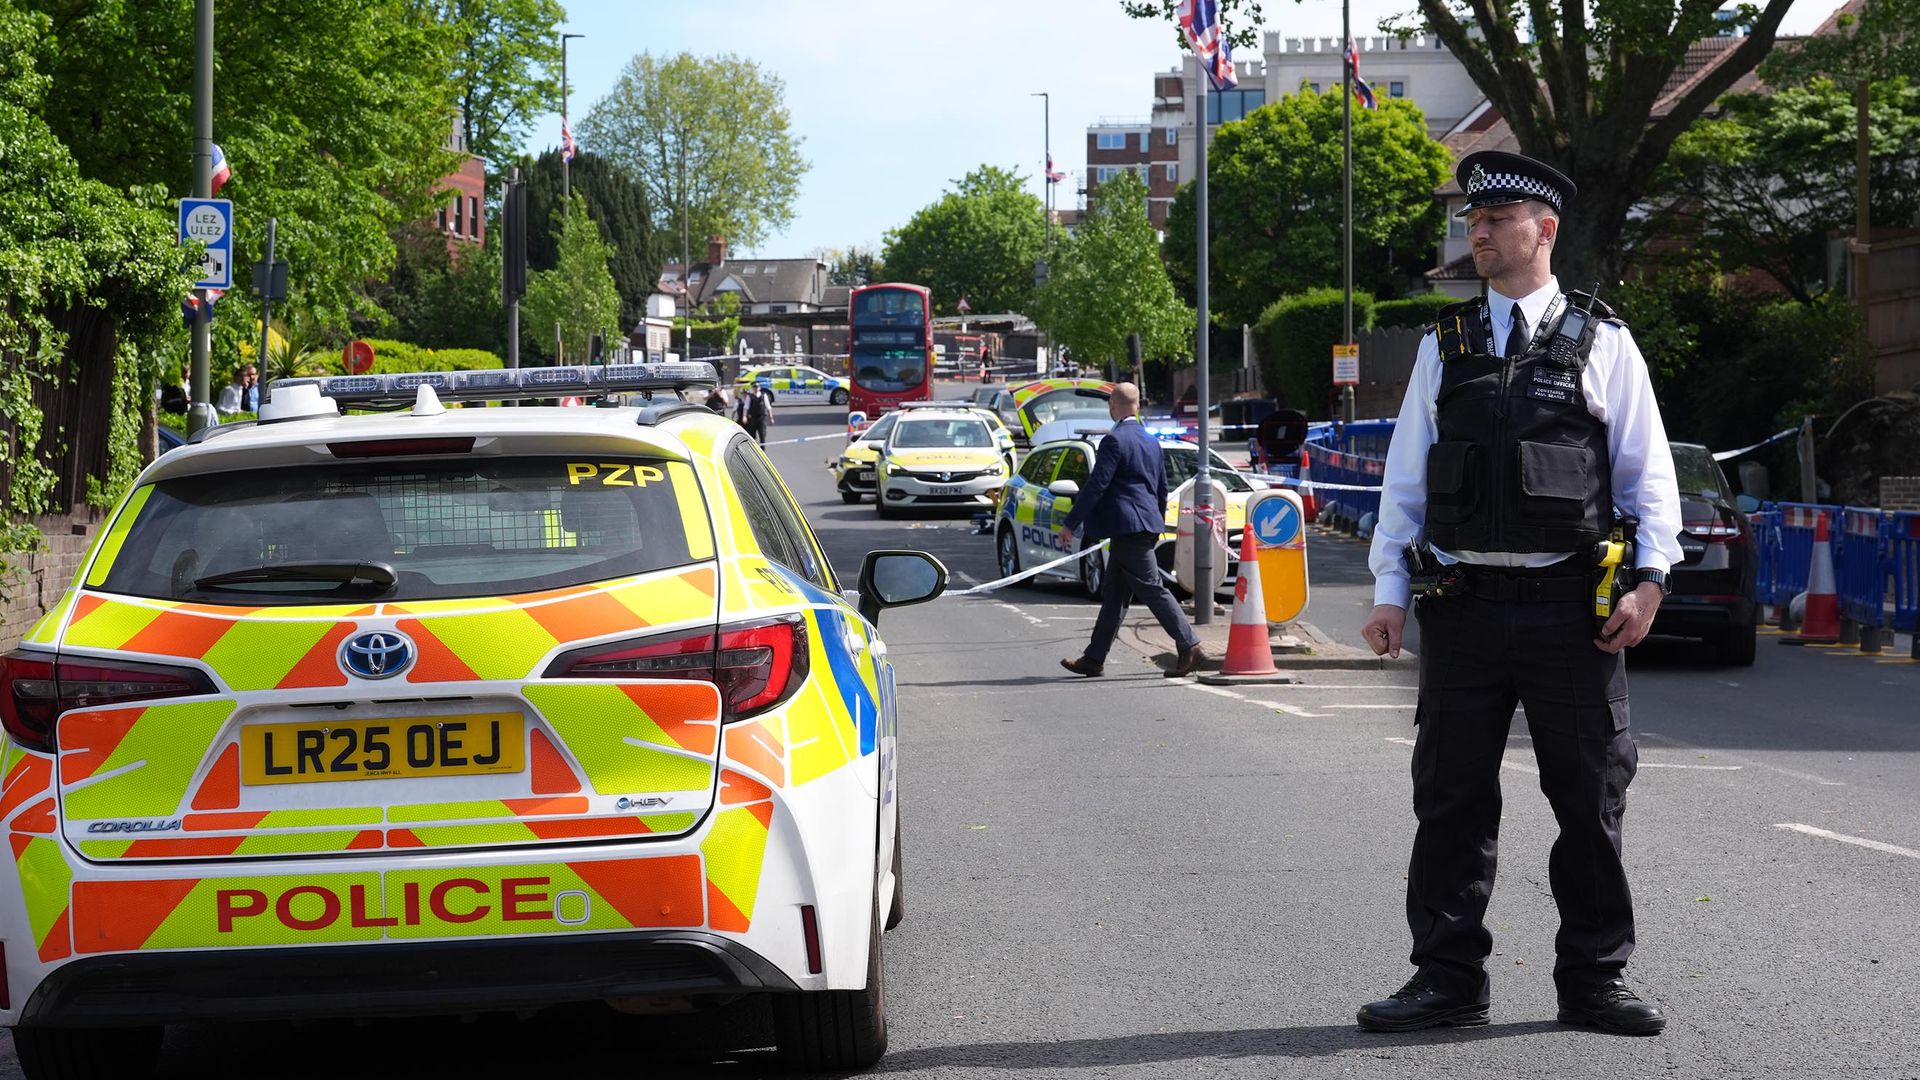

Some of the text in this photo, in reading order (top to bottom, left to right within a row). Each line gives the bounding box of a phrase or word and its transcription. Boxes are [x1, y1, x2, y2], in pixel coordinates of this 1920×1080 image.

[195, 214, 216, 224] LEZ
[190, 225, 221, 236] ULEZ
[1533, 377, 1576, 389] POLICE OFFICER
[566, 463, 664, 487] PZP
[265, 721, 500, 775] LR25 OEJ
[631, 797, 674, 807] HEV
[87, 819, 182, 833] COROLLA
[216, 876, 554, 933] POLICE
